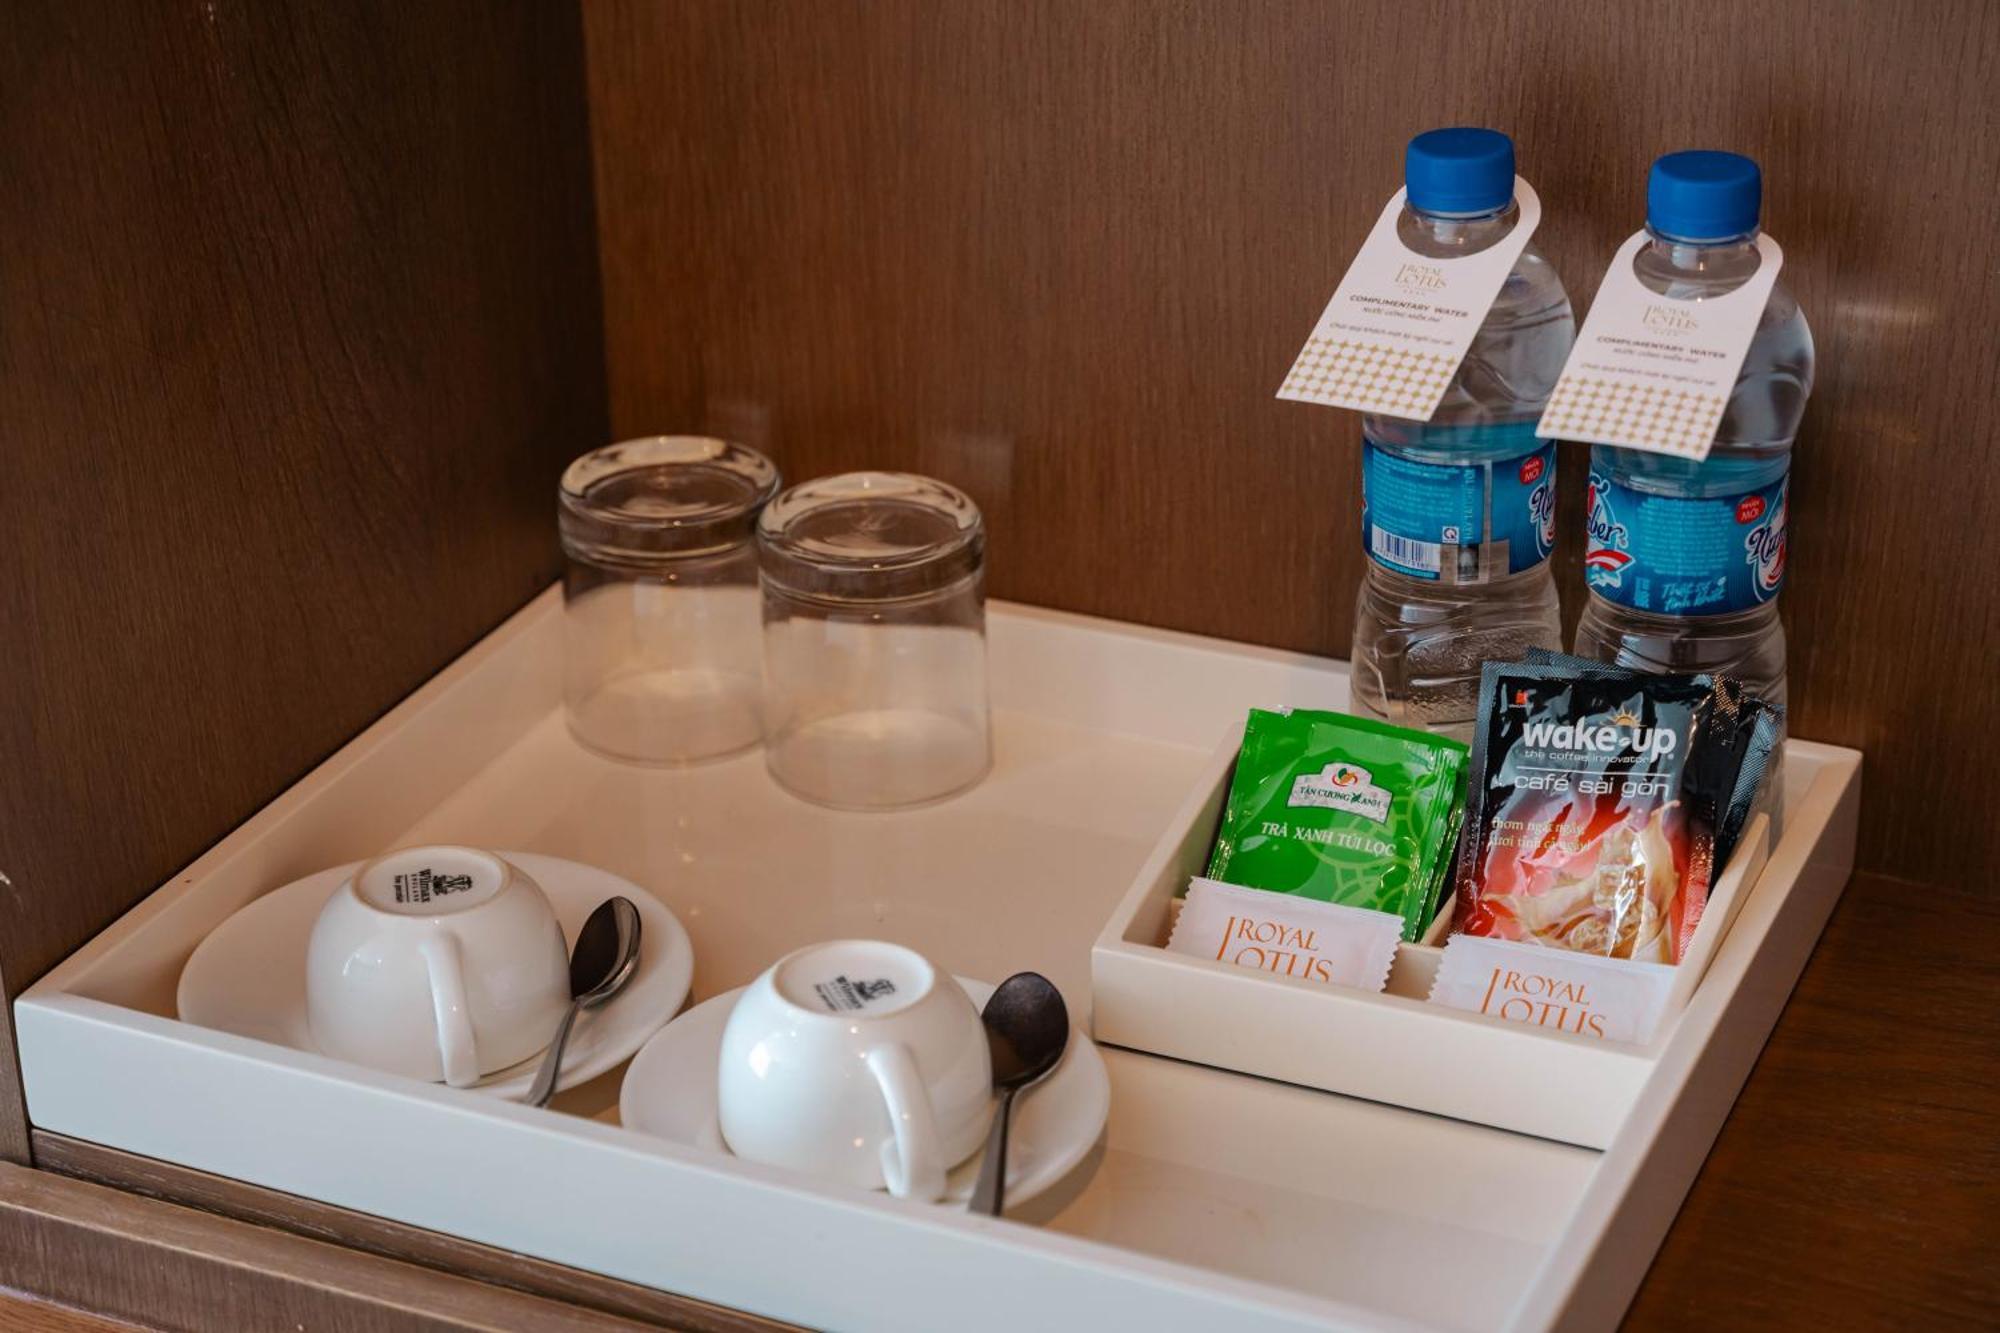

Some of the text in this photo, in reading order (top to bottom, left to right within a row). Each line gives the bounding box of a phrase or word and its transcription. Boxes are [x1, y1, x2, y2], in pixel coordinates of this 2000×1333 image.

[1349, 294, 1469, 318] COMPLIMENTARY WATER
[1597, 336, 1727, 359] COMPLIMENTARY WATER
[1524, 750, 1649, 764] the coffee innovator
[1514, 772, 1670, 798] café sài gòn
[1293, 826, 1334, 844] XANH
[1337, 832, 1361, 850] TÚI
[1365, 839, 1397, 858] LỌC
[1237, 918, 1319, 951] ROYAL
[1503, 970, 1590, 1005] ROYAL
